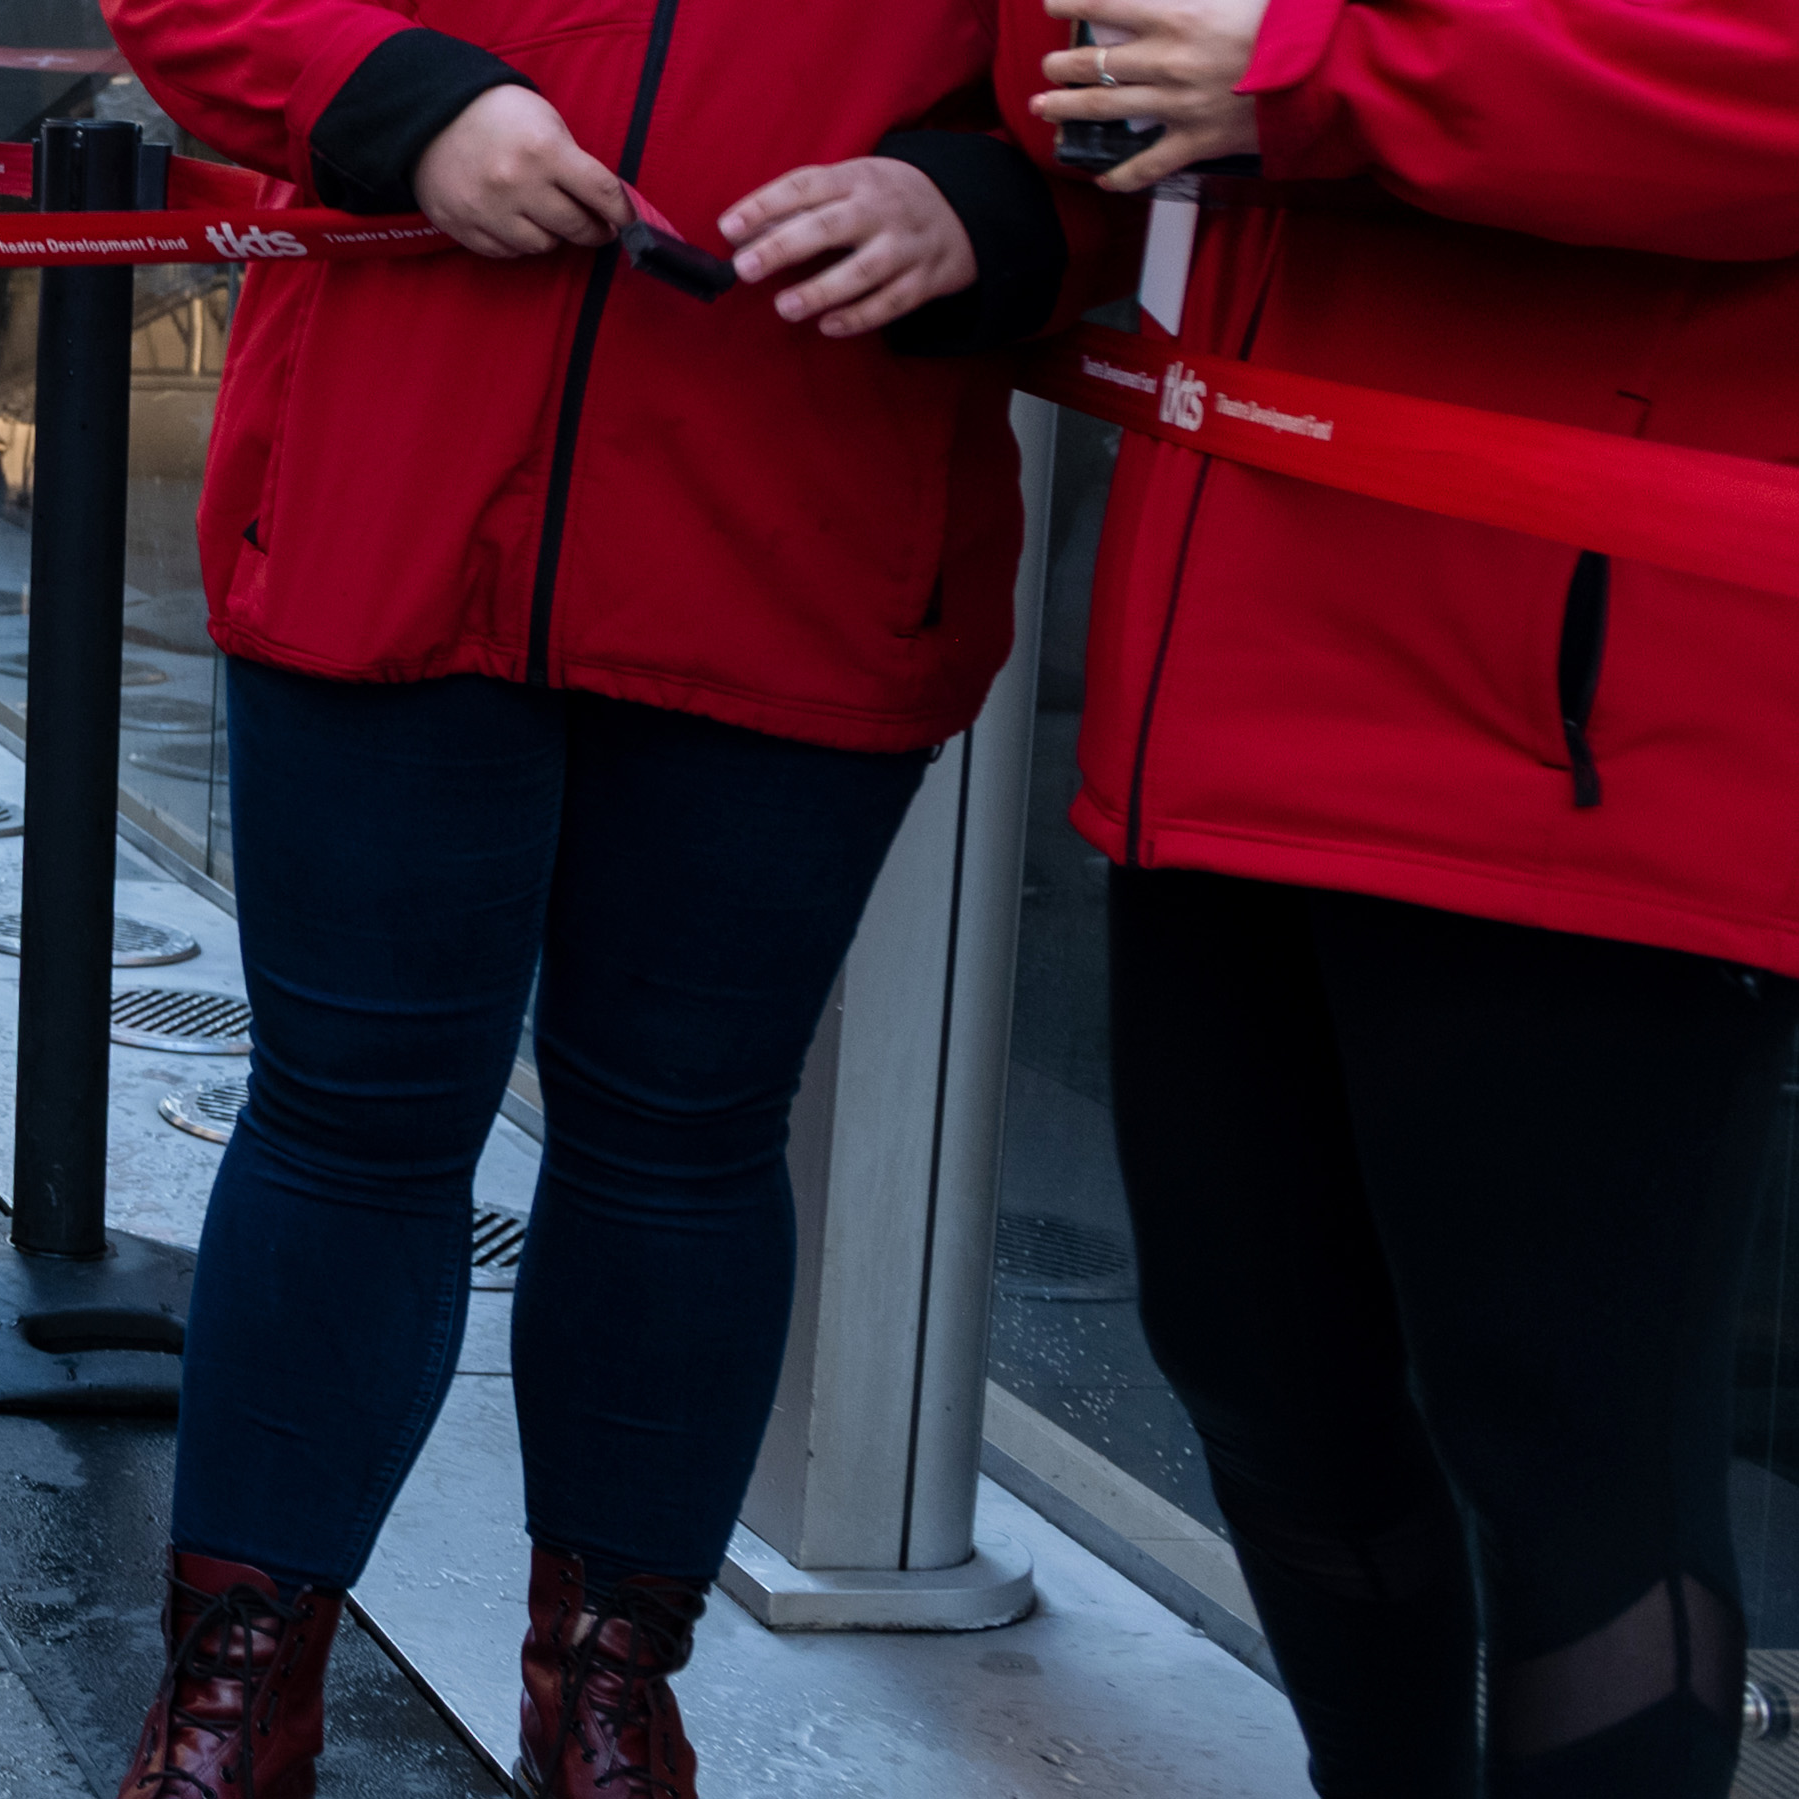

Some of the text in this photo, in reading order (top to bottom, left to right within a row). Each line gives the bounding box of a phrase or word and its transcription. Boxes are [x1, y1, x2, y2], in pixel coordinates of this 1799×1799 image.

[46, 236, 148, 255] Development
[146, 235, 189, 251] Fund
[204, 221, 308, 259] tkts
[322, 232, 390, 245] Theatre
[1158, 360, 1207, 432] tkts
